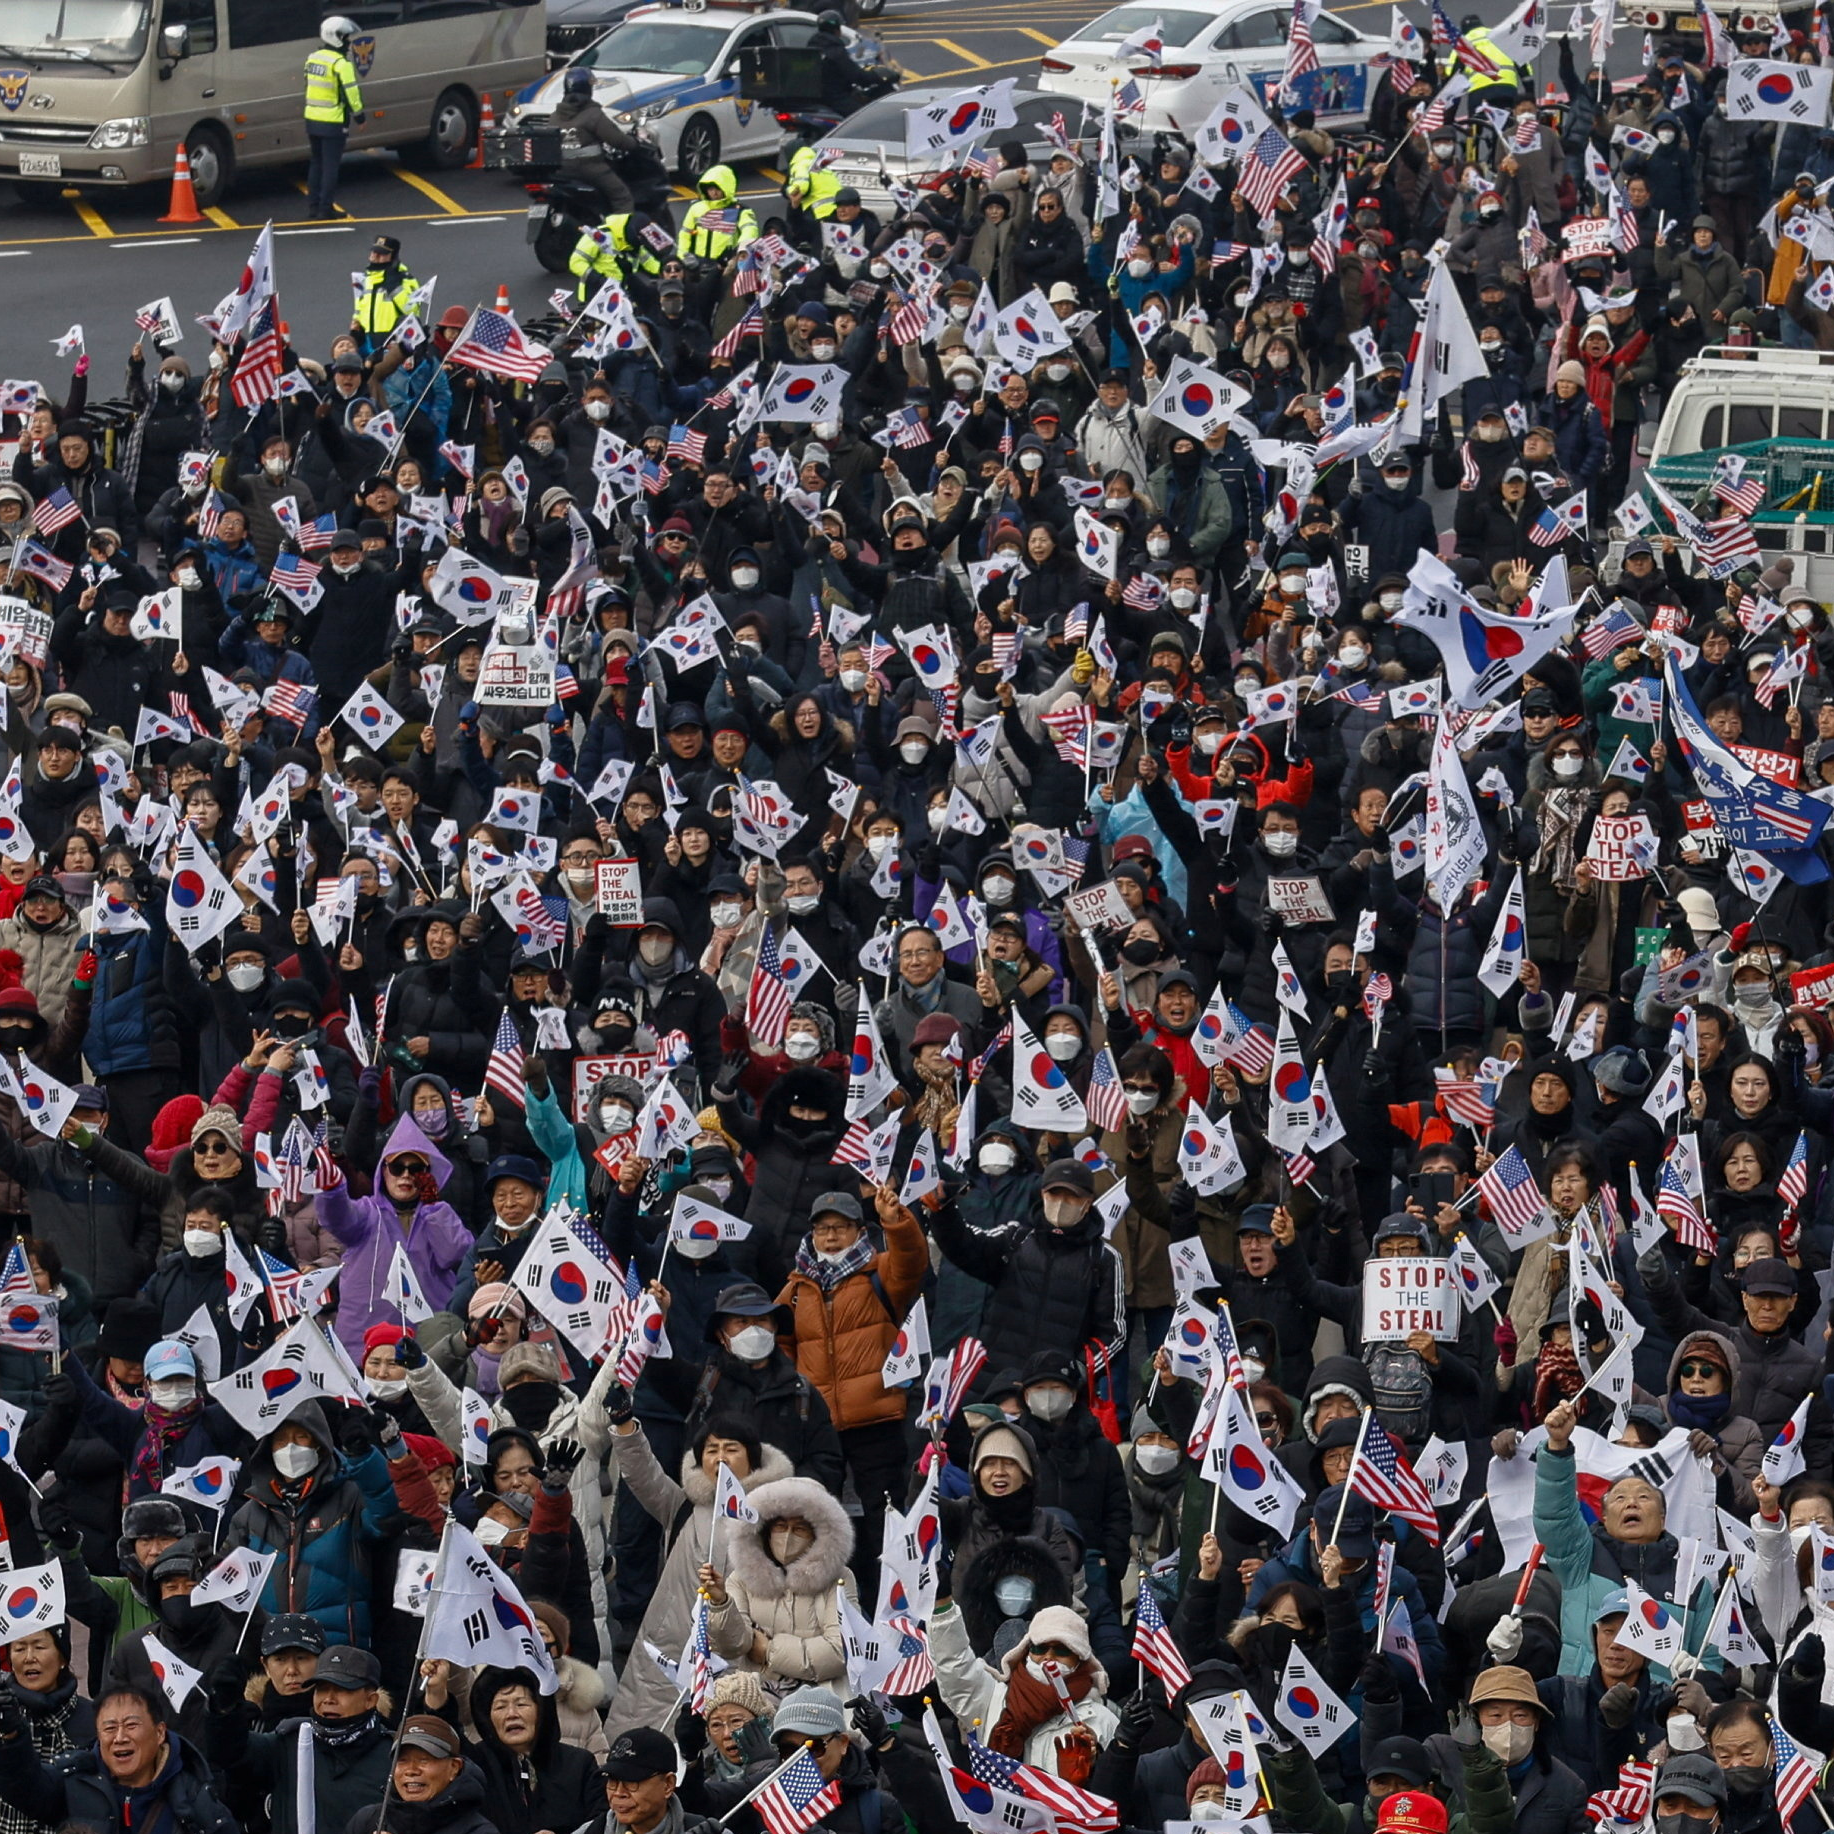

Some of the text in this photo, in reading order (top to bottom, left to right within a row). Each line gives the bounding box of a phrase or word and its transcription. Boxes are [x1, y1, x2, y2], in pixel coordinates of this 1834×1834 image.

[1568, 221, 1605, 237] STOP
[1567, 241, 1610, 258] STEAL
[1595, 820, 1643, 842] STOP
[602, 868, 630, 877] STOP
[602, 880, 623, 889] THE
[1273, 881, 1309, 897] STOP
[602, 890, 637, 901] STEAL
[1073, 888, 1107, 912] STOP
[1282, 897, 1308, 908] THE
[1085, 909, 1110, 925] THE
[1379, 1266, 1446, 1289] STOP
[1395, 1291, 1430, 1307] THE
[1379, 1310, 1444, 1332] STEAL
